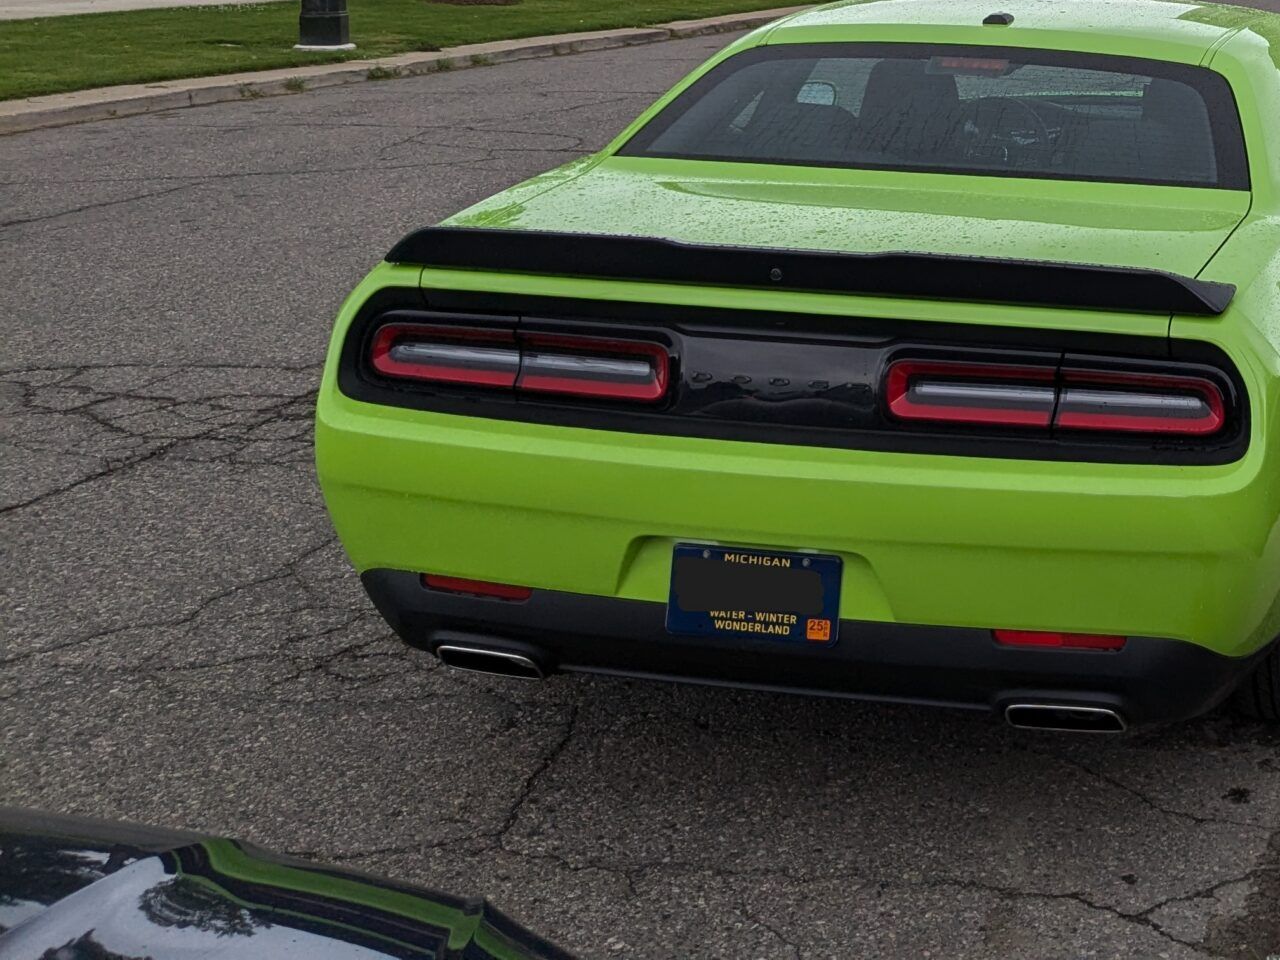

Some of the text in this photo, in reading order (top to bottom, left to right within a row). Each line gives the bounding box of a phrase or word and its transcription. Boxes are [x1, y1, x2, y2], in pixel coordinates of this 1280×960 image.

[724, 553, 791, 567] MICHIGAN
[755, 611, 797, 625] WINTER
[714, 620, 790, 635] WONDERLAND
[808, 620, 824, 632] 25
